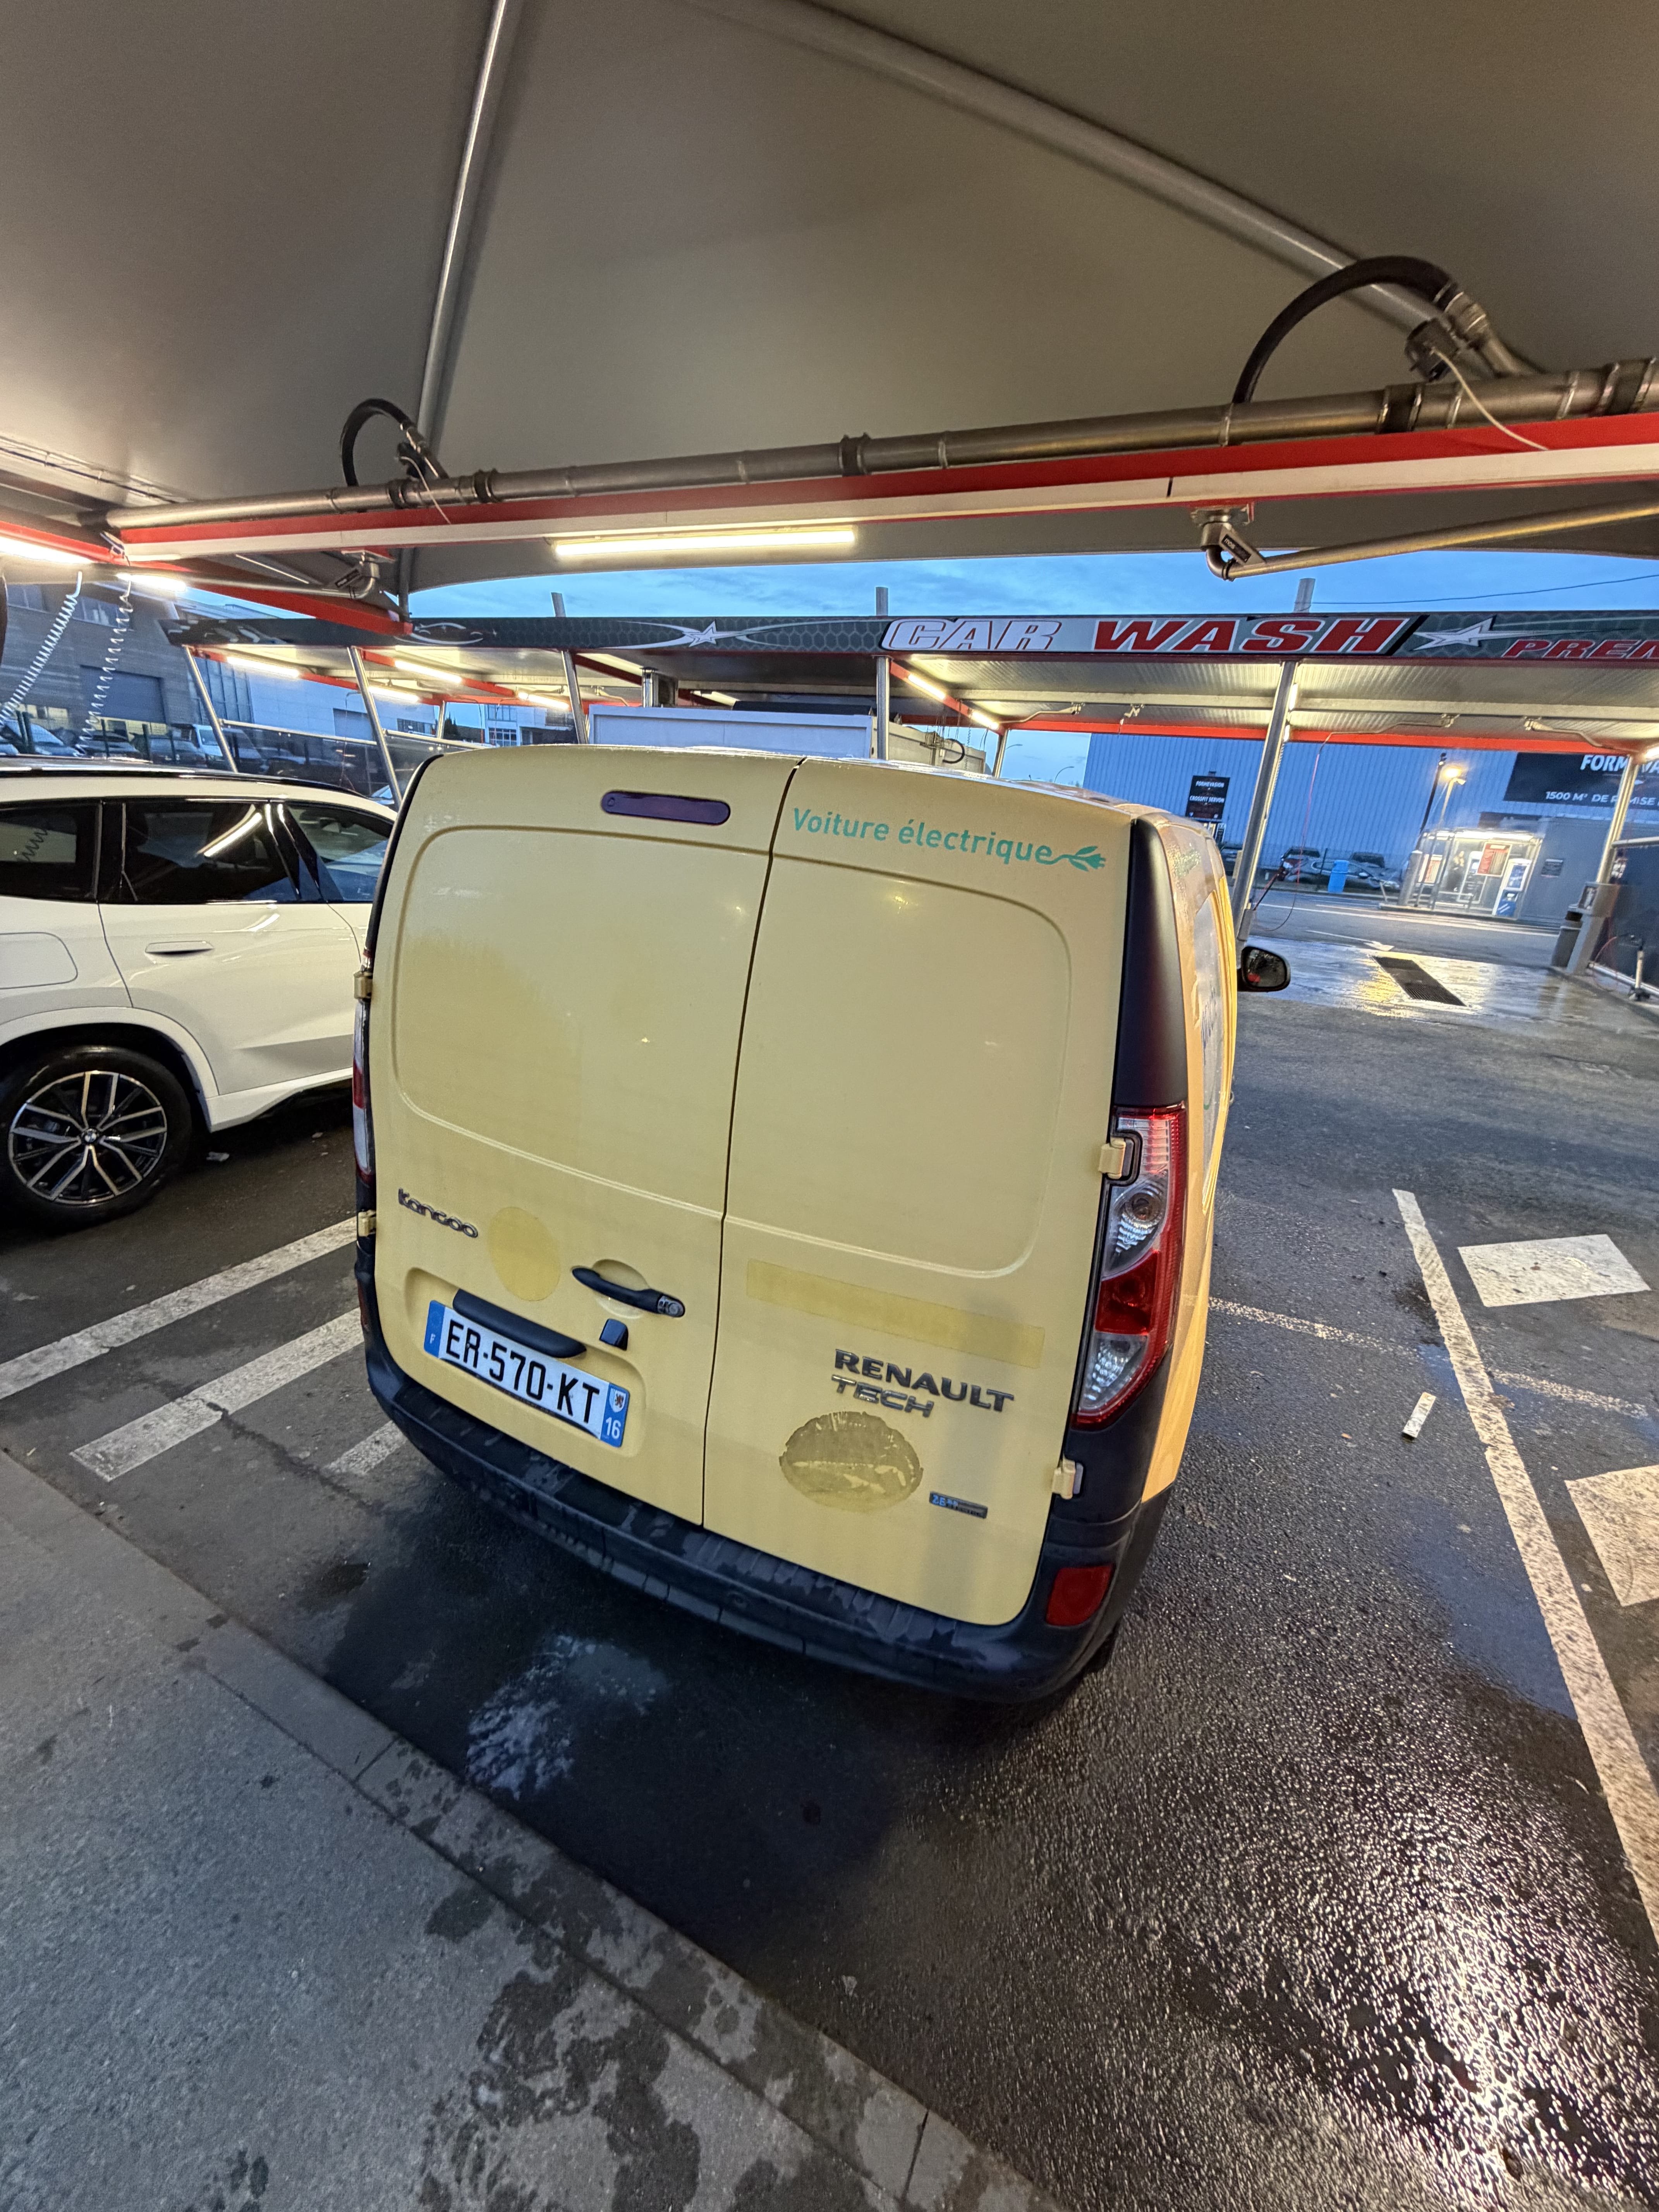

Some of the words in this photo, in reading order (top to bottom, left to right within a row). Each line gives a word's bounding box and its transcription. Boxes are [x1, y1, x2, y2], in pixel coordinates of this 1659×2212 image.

[888, 620, 1062, 650] CAR
[1094, 619, 1409, 653] WASH
[1546, 791, 1571, 800] 1500
[1591, 794, 1609, 803] DE
[1610, 795, 1657, 806] RMISE
[794, 808, 890, 841] Voiture
[898, 819, 1054, 865] électrique
[430, 1333, 436, 1344] F
[446, 1319, 600, 1424] ER-570-KT
[835, 1349, 1014, 1412] RENAULT
[831, 1374, 934, 1417] TECH
[605, 1417, 622, 1439] 16
